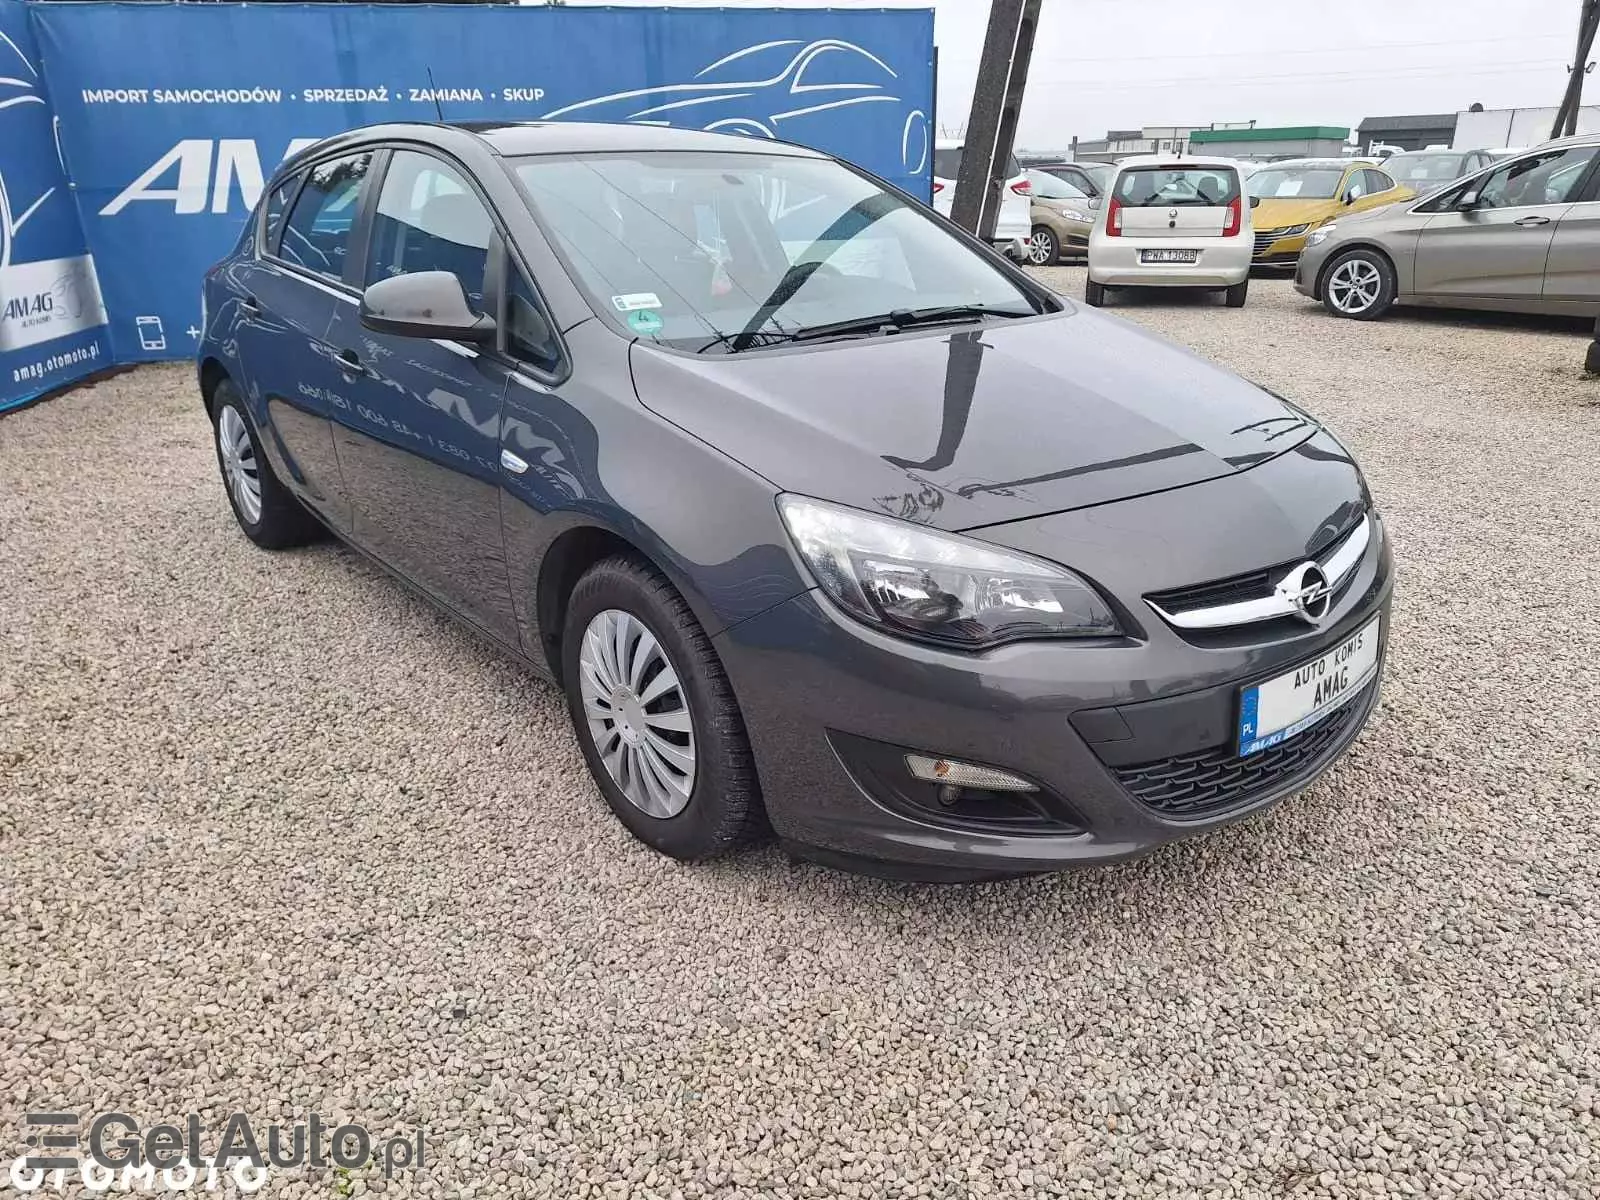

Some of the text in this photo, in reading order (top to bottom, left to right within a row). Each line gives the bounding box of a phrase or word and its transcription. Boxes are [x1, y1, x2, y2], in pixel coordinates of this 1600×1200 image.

[82, 85, 544, 103] IMPORT SAMOCHODÓW SPRZEDAŻ ZAMIANA SKUP
[13, 342, 100, 383] amag.otomoto.pl
[1294, 659, 1326, 689] AUTO
[1335, 633, 1362, 666] KOMIS
[1313, 666, 1348, 709] AMAG
[1242, 721, 1254, 737] PL
